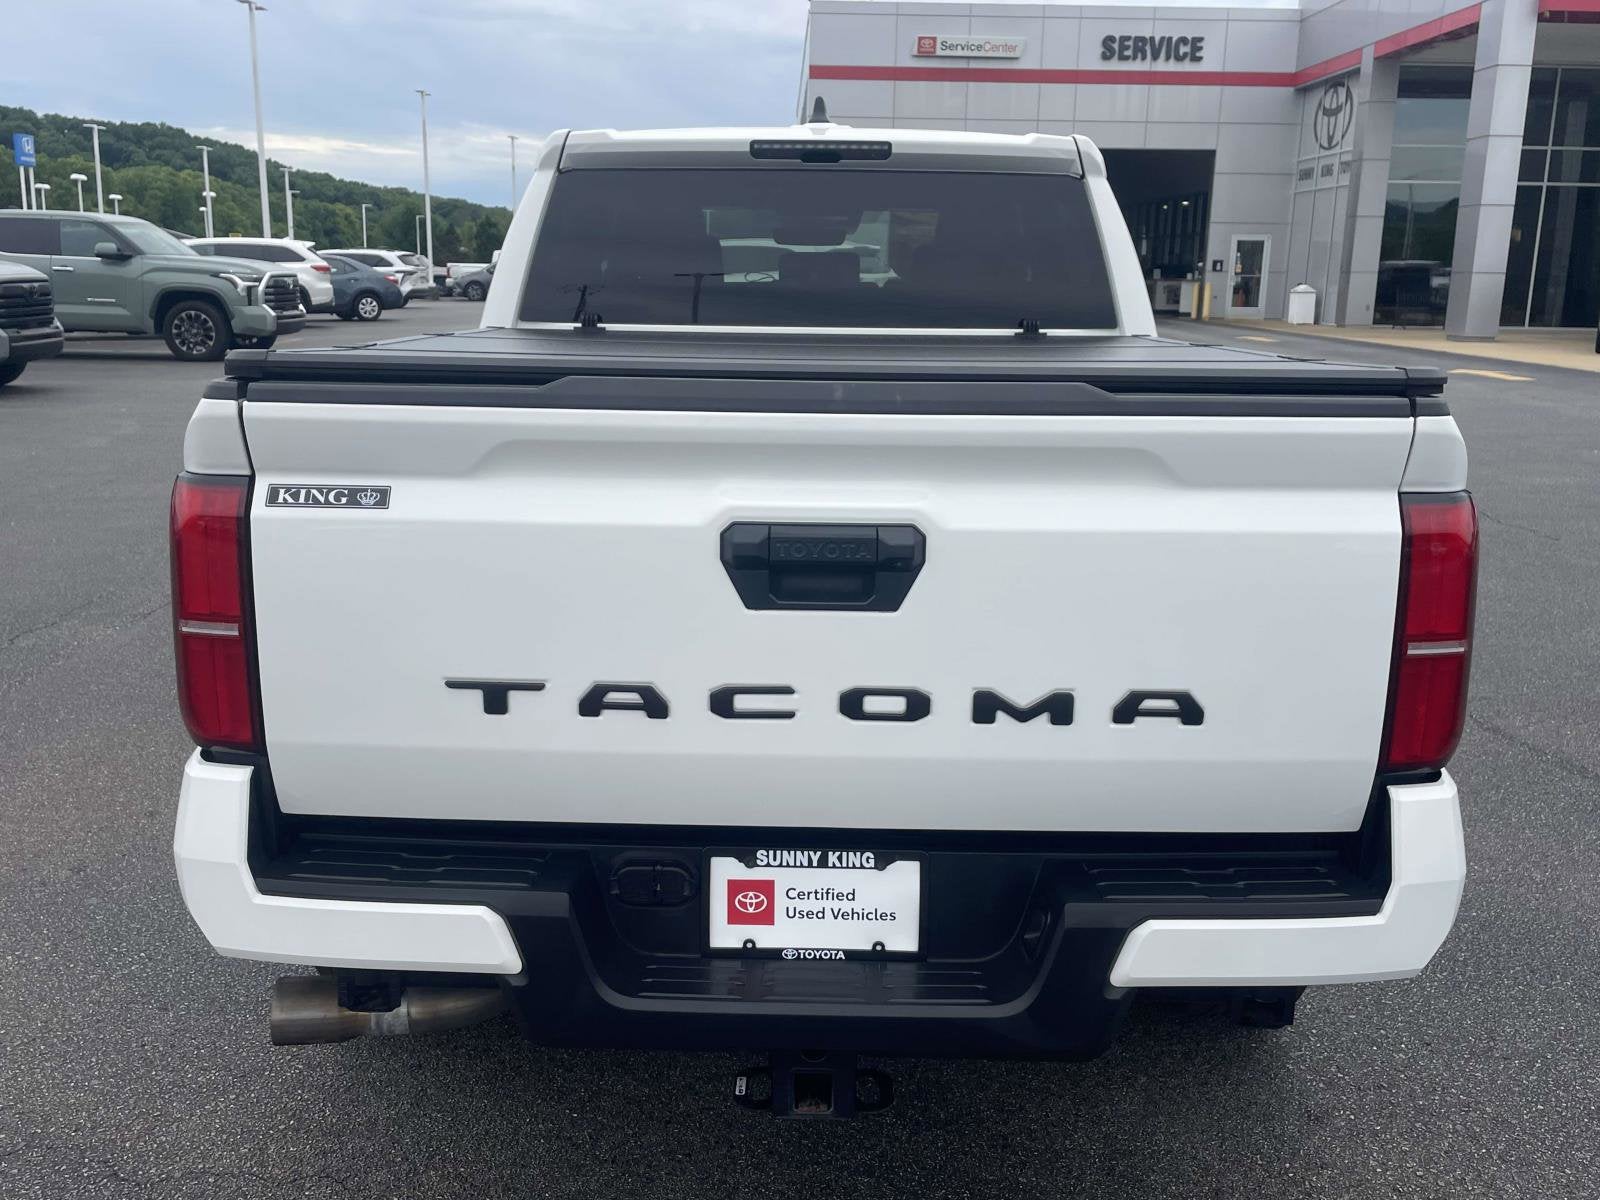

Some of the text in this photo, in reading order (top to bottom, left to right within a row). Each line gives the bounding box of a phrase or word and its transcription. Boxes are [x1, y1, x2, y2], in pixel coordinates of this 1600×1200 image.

[940, 40, 1018, 53] ServiceCenter
[1101, 34, 1204, 62] SERVICE
[275, 487, 349, 504] KING
[776, 542, 873, 559] TOYOTA
[445, 678, 1205, 726] TACOMA
[756, 849, 875, 868] SUNNY KING
[785, 887, 856, 902] Certified
[785, 906, 896, 921] Used Vehicles
[799, 950, 845, 960] TOYOTA
